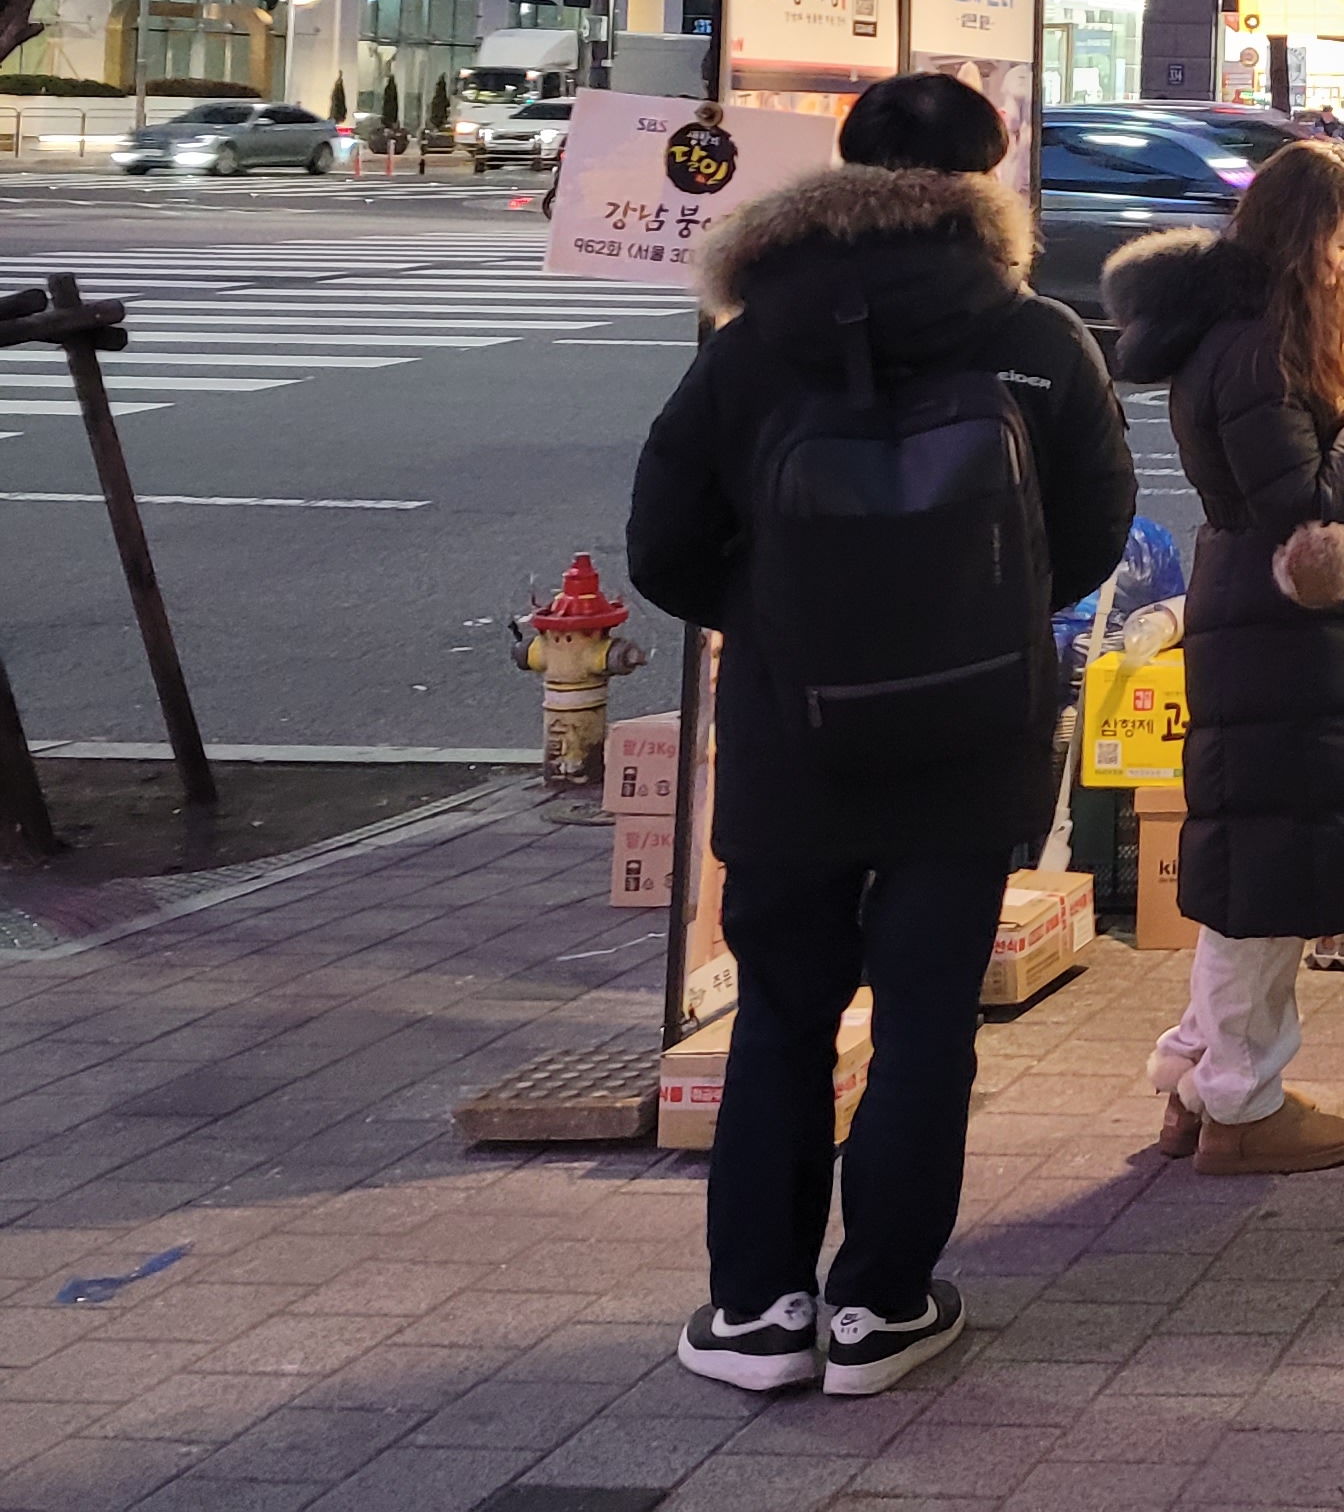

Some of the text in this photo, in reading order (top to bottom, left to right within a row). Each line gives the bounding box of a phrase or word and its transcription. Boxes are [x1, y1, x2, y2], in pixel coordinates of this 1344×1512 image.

[637, 117, 669, 133] SBS
[669, 145, 729, 185] 달인
[605, 200, 669, 233] 강남
[574, 237, 622, 257] 962화
[1101, 718, 1154, 738] 삼형제
[1158, 859, 1177, 876] ki
